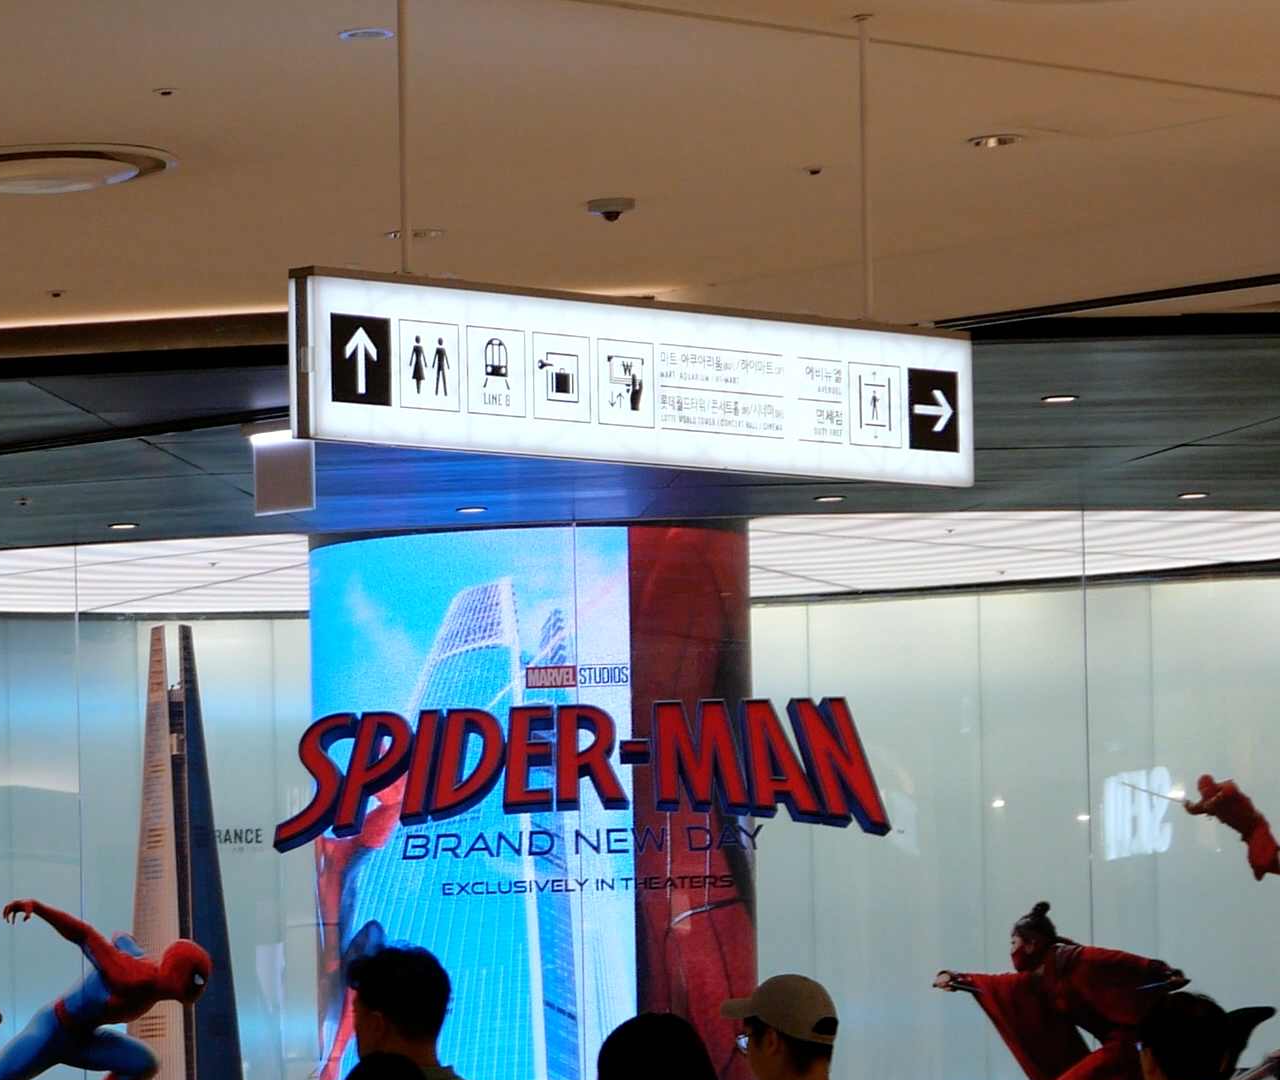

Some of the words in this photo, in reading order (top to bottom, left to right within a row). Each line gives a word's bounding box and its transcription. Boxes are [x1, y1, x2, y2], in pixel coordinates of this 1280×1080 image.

[483, 392, 503, 406] LINE
[527, 667, 576, 688] MARVEL
[579, 666, 629, 685] STUDIOS
[273, 696, 893, 855] SPIDER-MAN
[400, 831, 567, 861] BRAND
[574, 827, 668, 855] NEW
[687, 824, 764, 851] DAY
[441, 878, 588, 897] EXCLUSIVELY
[595, 878, 615, 892] IN
[619, 876, 736, 892] THEATERS
